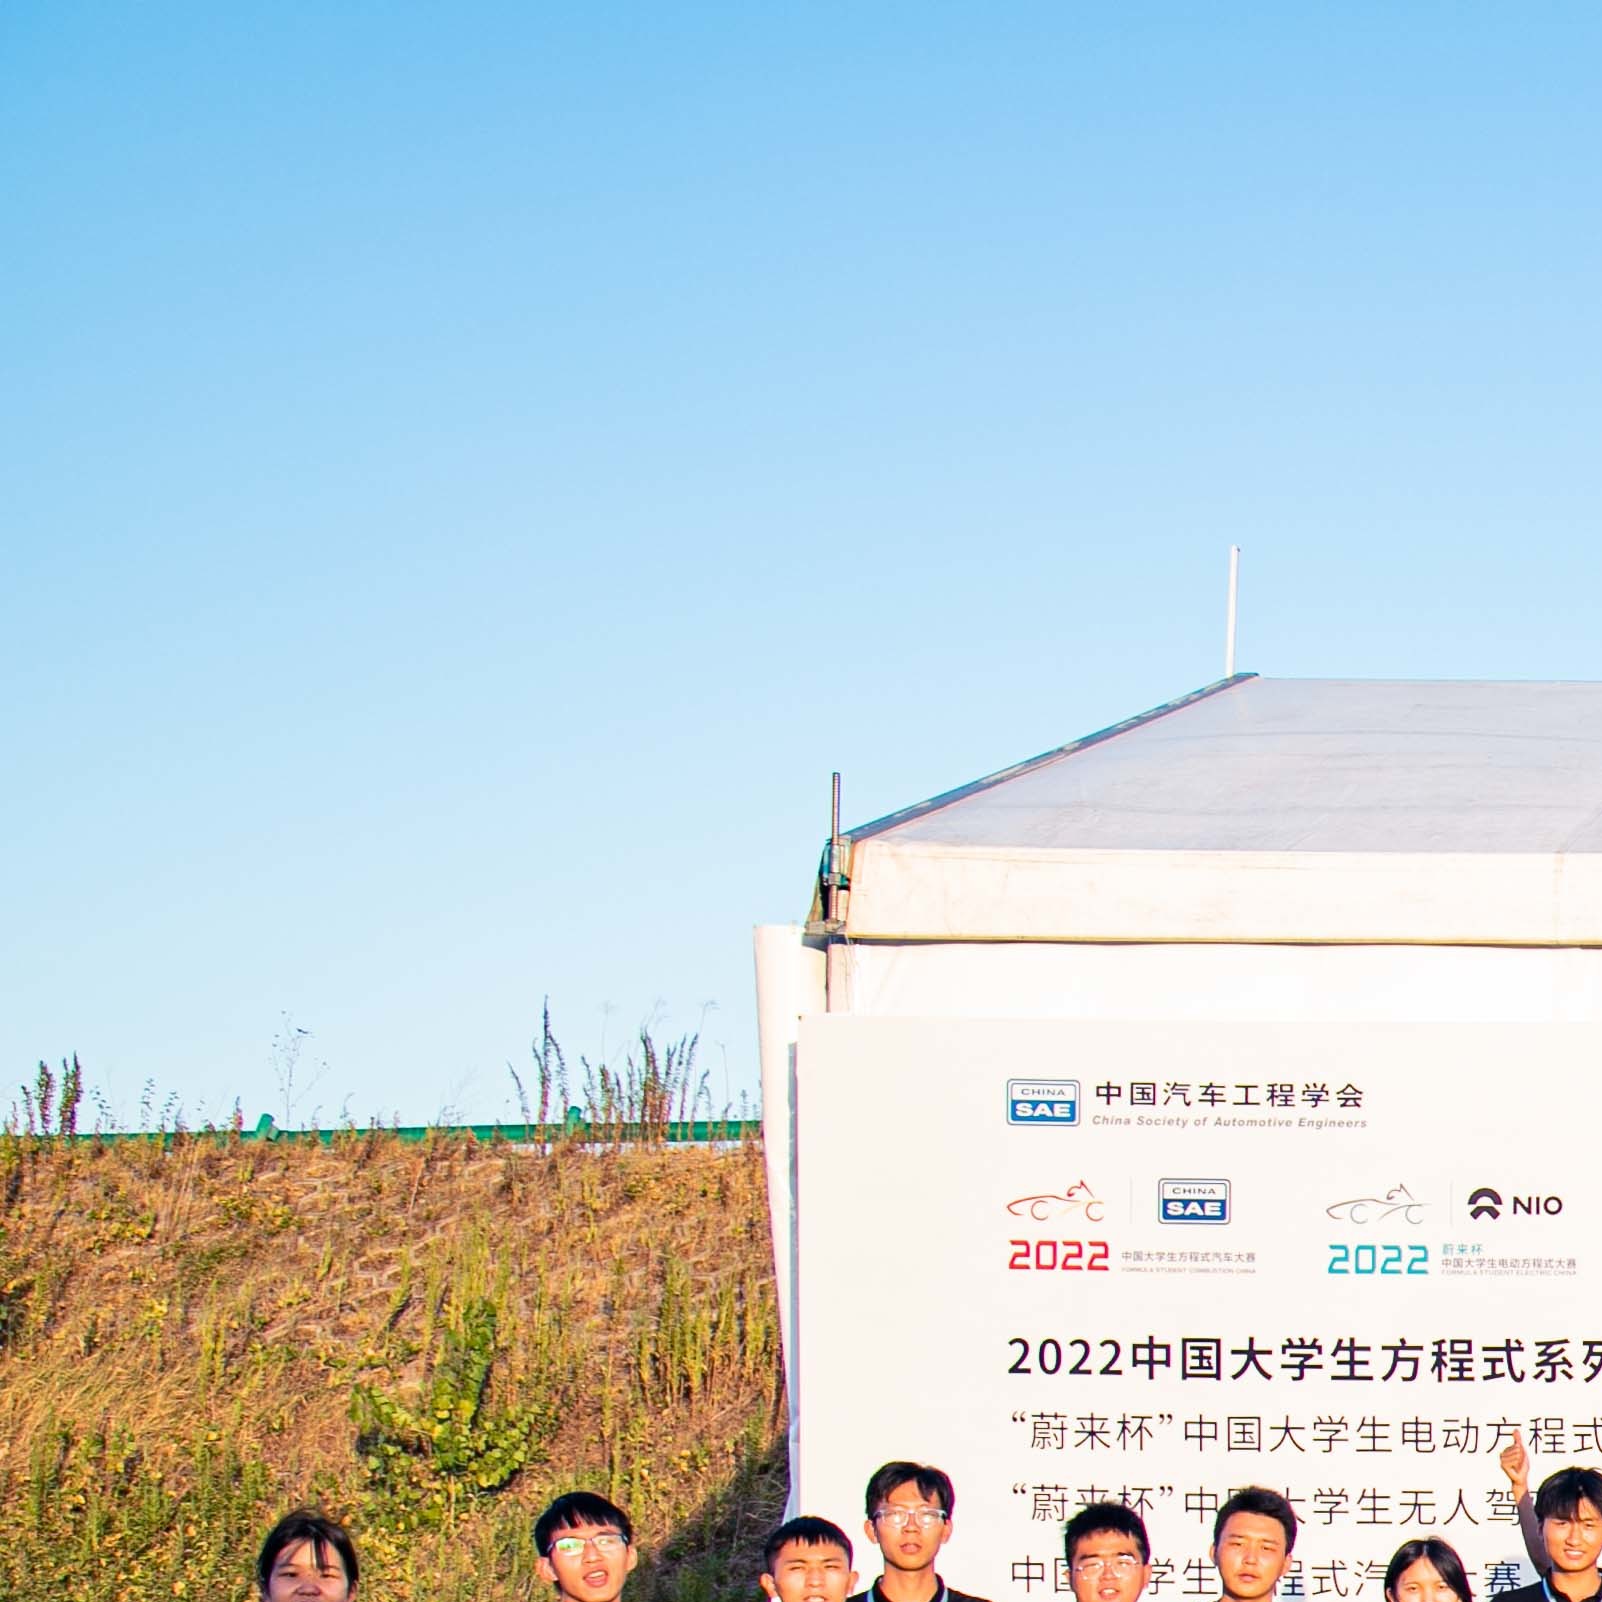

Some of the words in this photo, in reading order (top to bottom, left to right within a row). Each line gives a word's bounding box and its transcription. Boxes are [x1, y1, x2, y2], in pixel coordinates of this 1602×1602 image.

[1021, 1087, 1066, 1096] CHINA
[1095, 1081, 1364, 1108] 中国汽车工程学会
[1015, 1102, 1071, 1118] SAE
[1092, 1115, 1131, 1126] China
[1136, 1115, 1189, 1129] Society
[1193, 1115, 1208, 1127] of
[1213, 1116, 1293, 1128] Automotive
[1298, 1117, 1368, 1130] Engineers
[1172, 1186, 1216, 1195] CHINA
[1166, 1201, 1222, 1217] SAE
[1512, 1196, 1563, 1216] NIO
[1008, 1240, 1110, 1271] 2022
[1121, 1251, 1256, 1263] 中国大学生方程式汽车大赛
[1328, 1245, 1429, 1275] 2022
